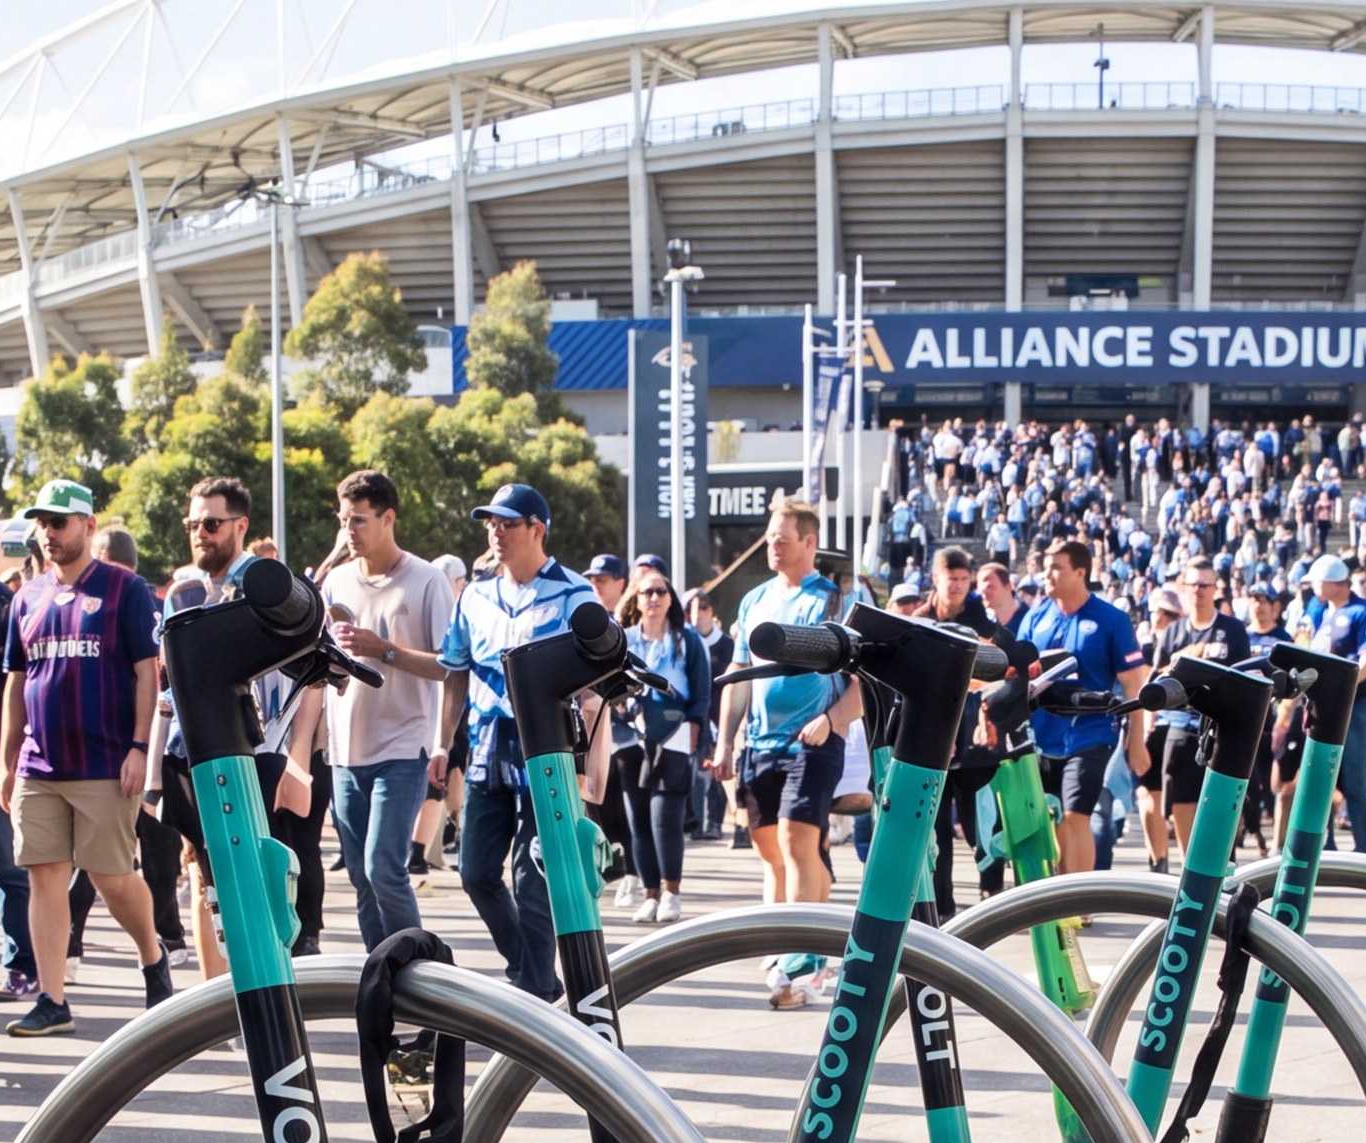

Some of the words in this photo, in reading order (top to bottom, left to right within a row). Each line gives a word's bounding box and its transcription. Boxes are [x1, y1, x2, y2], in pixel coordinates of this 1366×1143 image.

[905, 326, 1154, 369] ALLIANCE
[803, 934, 875, 1140] SCOOTY
[1140, 889, 1204, 1052] SCOOTY
